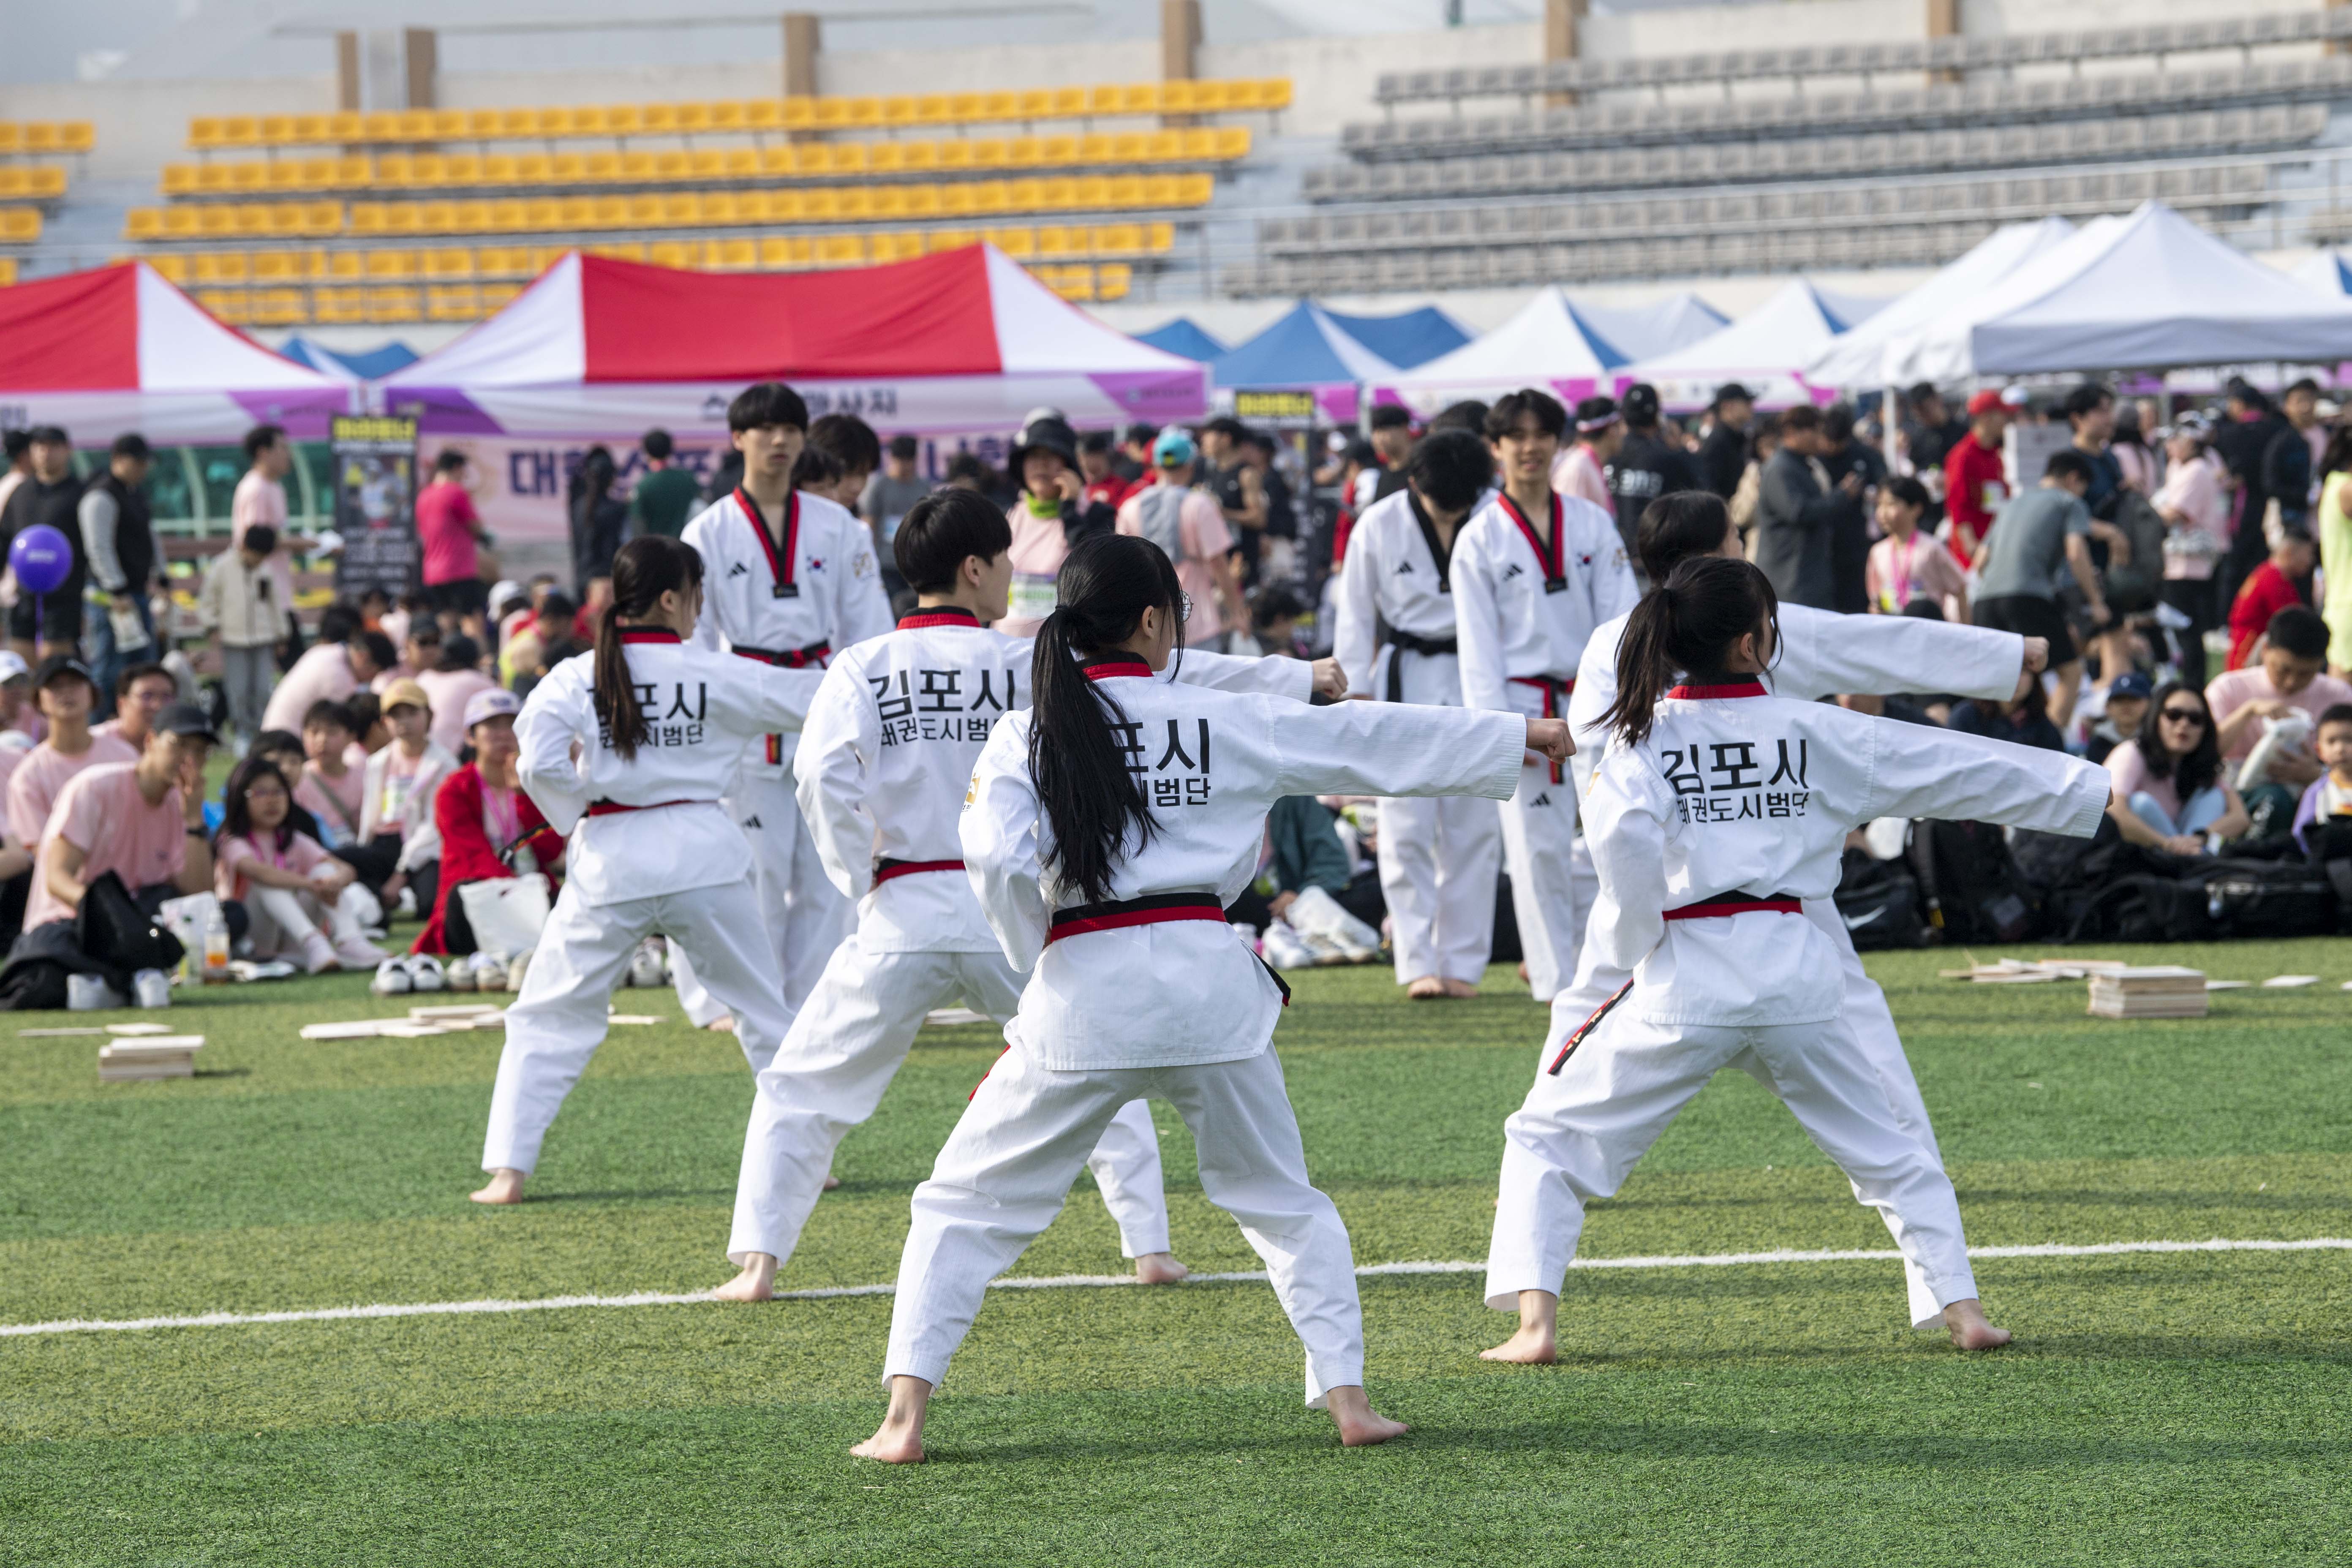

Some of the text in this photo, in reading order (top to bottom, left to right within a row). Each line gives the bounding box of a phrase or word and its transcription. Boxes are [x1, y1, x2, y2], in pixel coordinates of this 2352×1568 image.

[587, 683, 706, 727] 포시
[868, 669, 1015, 721] 김포시
[881, 717, 995, 746] 태권도시범
[1105, 718, 1210, 774] 포시
[1661, 739, 1809, 795] 김포시
[1677, 792, 1810, 824] 태권도시범단
